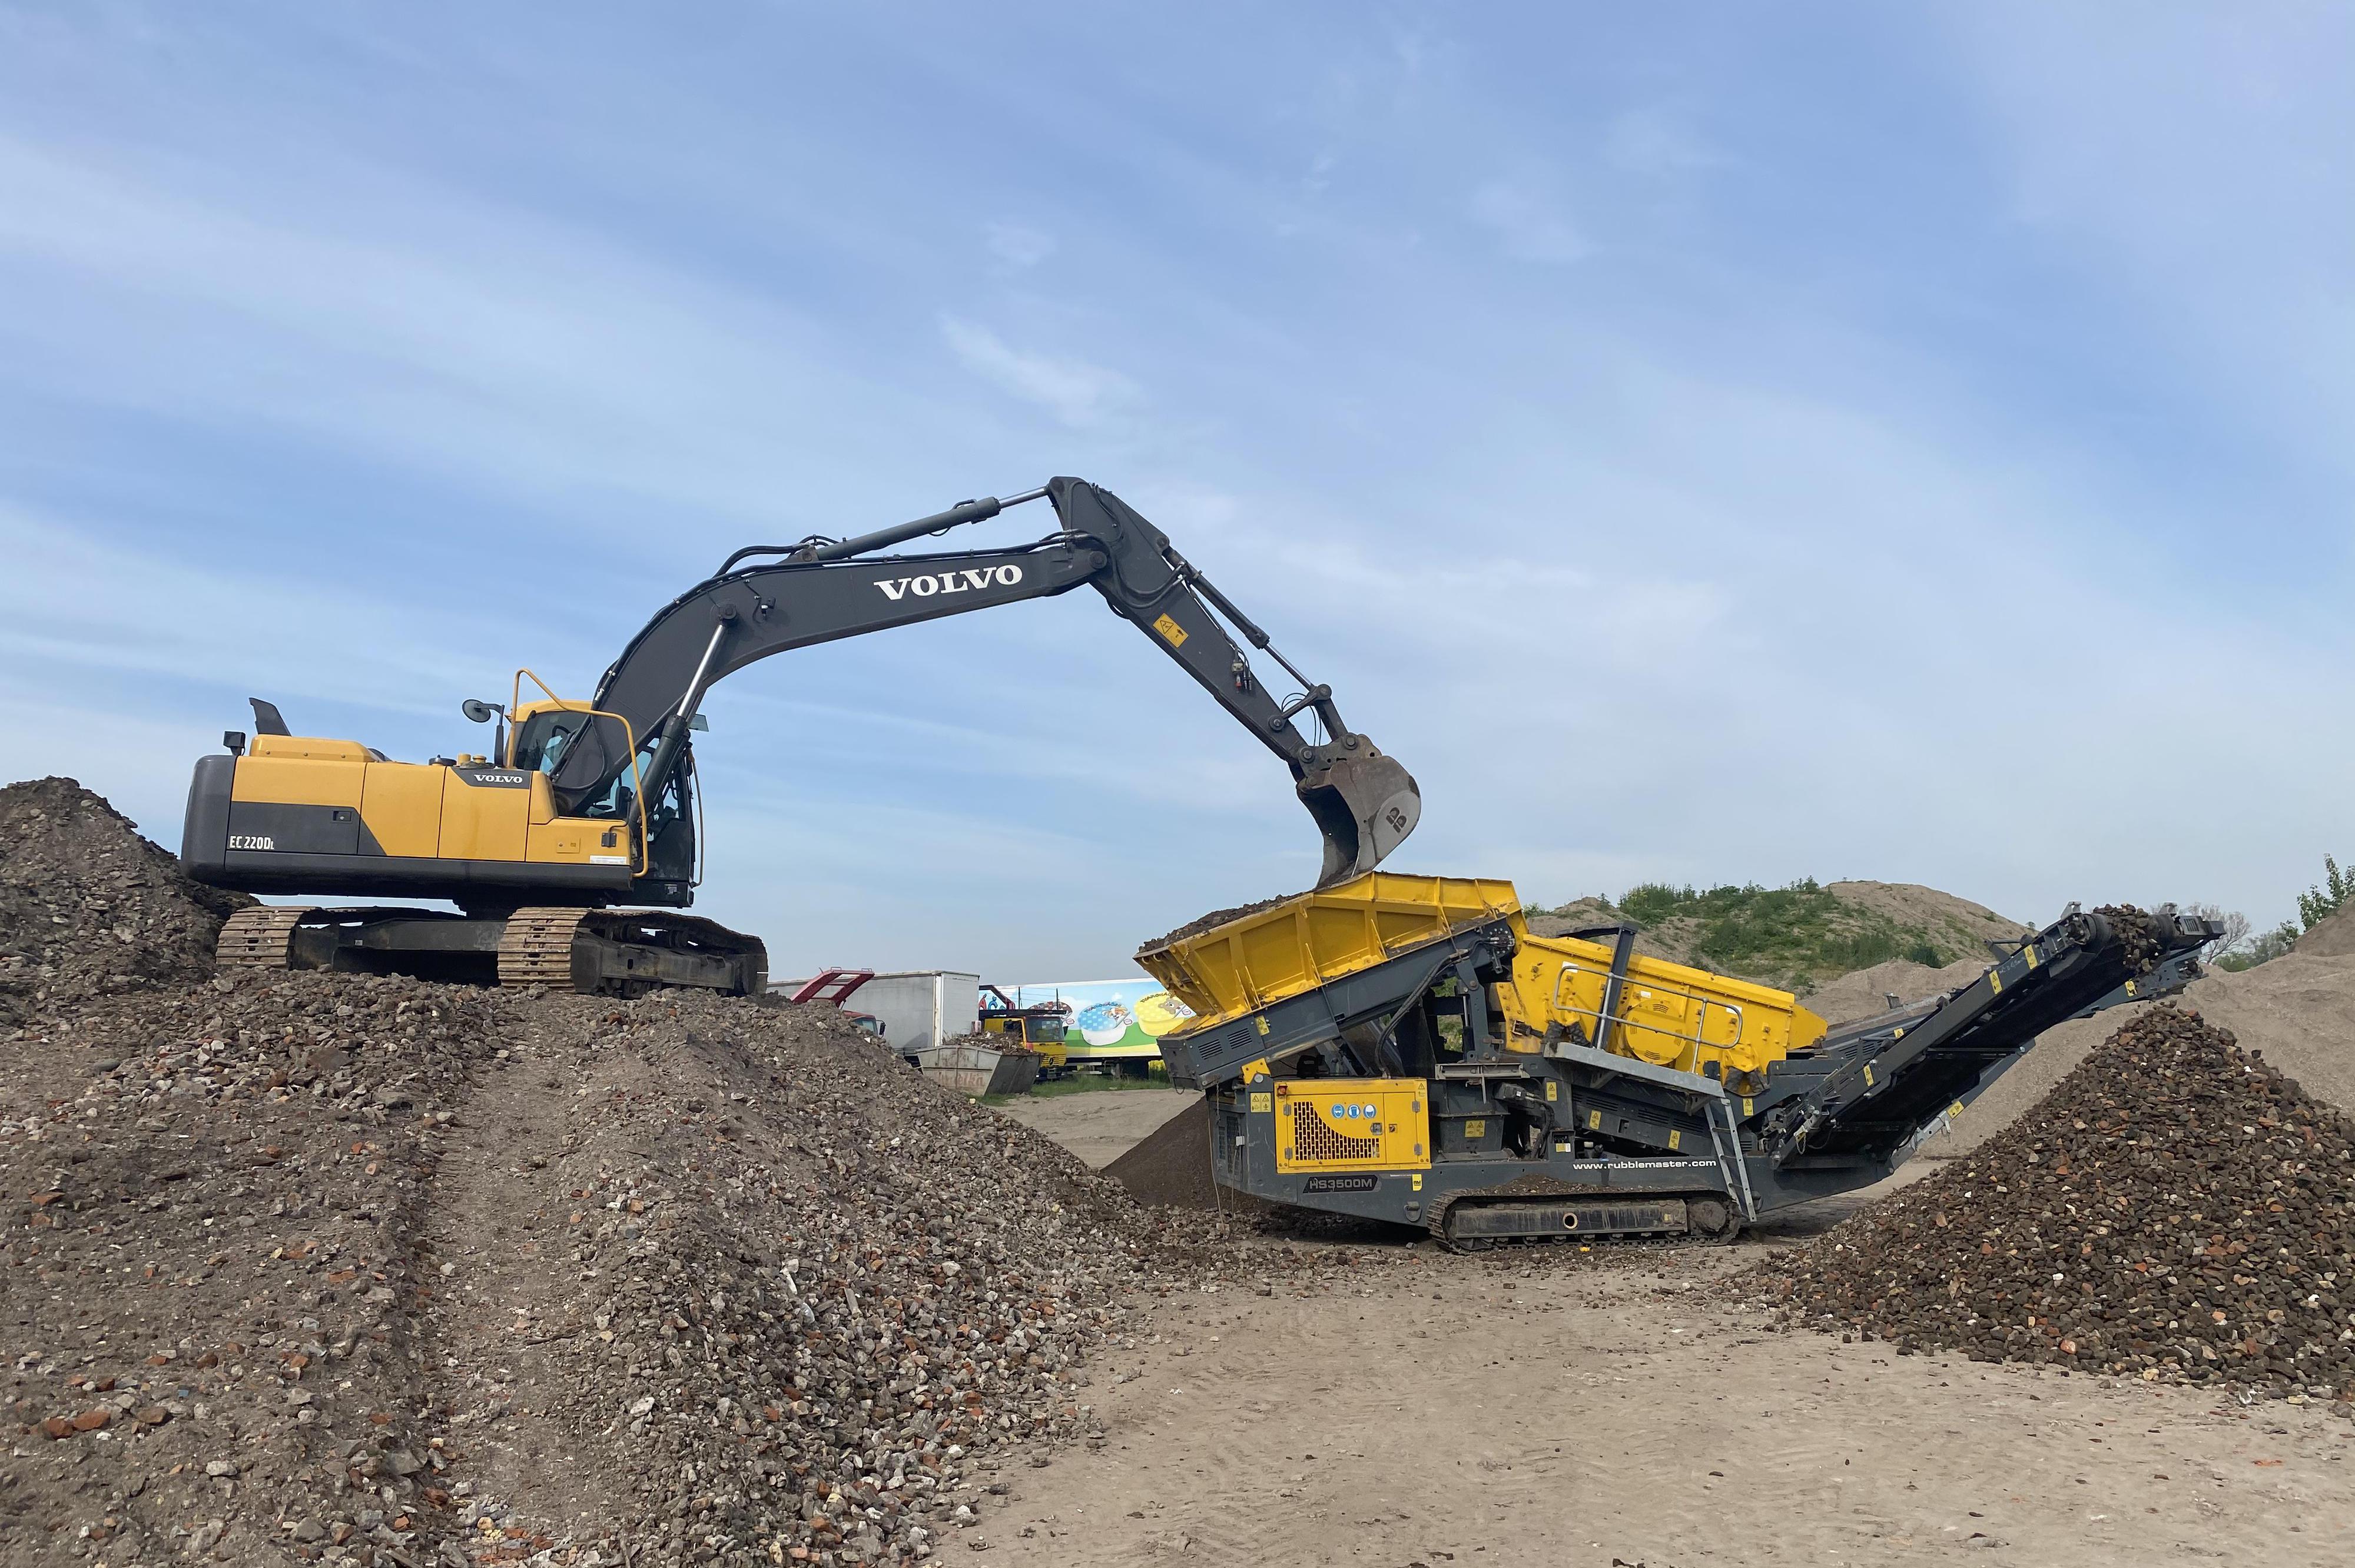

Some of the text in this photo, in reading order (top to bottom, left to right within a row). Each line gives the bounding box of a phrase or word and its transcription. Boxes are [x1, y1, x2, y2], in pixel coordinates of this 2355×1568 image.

[873, 564, 1023, 600] VOLVO
[473, 774, 523, 783] VOLVO
[229, 835, 243, 849] EC
[1573, 1160, 1717, 1170] www.rubblemaster.com
[1309, 1178, 1372, 1190] HS3500M
